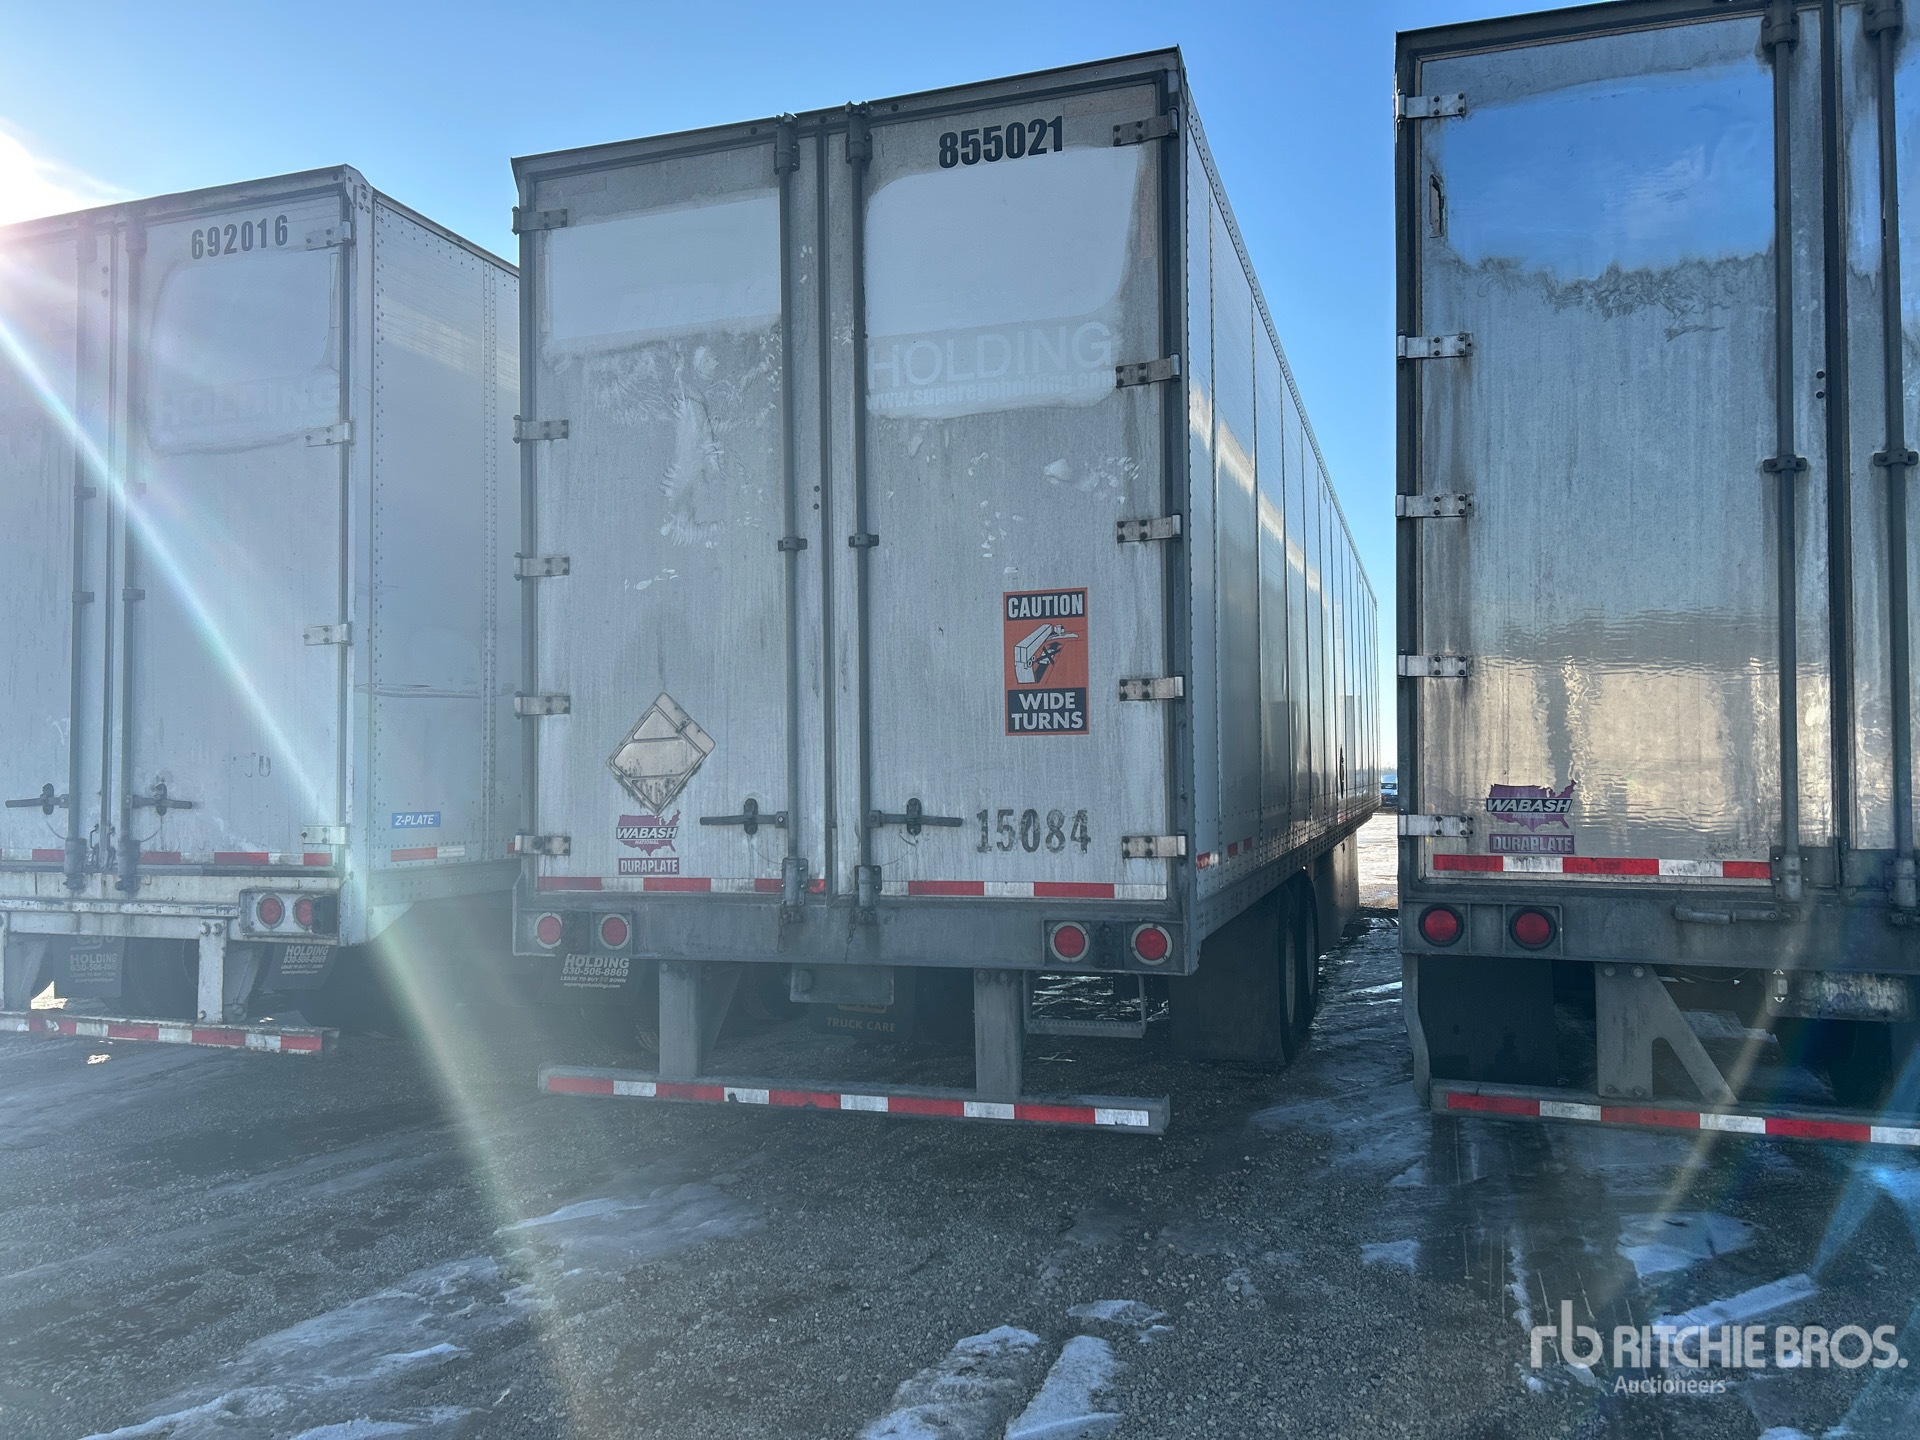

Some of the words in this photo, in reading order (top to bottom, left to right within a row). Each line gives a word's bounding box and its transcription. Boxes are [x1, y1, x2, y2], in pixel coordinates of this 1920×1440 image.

[939, 115, 1063, 169] 855021
[191, 214, 288, 260] 692016
[867, 321, 1112, 390] HOLDING
[1008, 594, 1083, 618] CAUTION
[1019, 692, 1076, 710] WIDE
[1011, 711, 1083, 730] TURNS
[1487, 799, 1571, 812] WABASH
[395, 814, 434, 826] Z-PLATE
[617, 828, 677, 839] WABASH
[976, 808, 1091, 854] 15084
[1493, 836, 1572, 852] DURAPLATE
[620, 860, 678, 873] DURAPLATE
[285, 945, 330, 956] HOLDING
[69, 953, 117, 965] HOLDING
[564, 953, 630, 969] HOLDING
[562, 966, 629, 977] 630-506-8869
[827, 1017, 863, 1030] TRUCK
[866, 1021, 896, 1033] CARE
